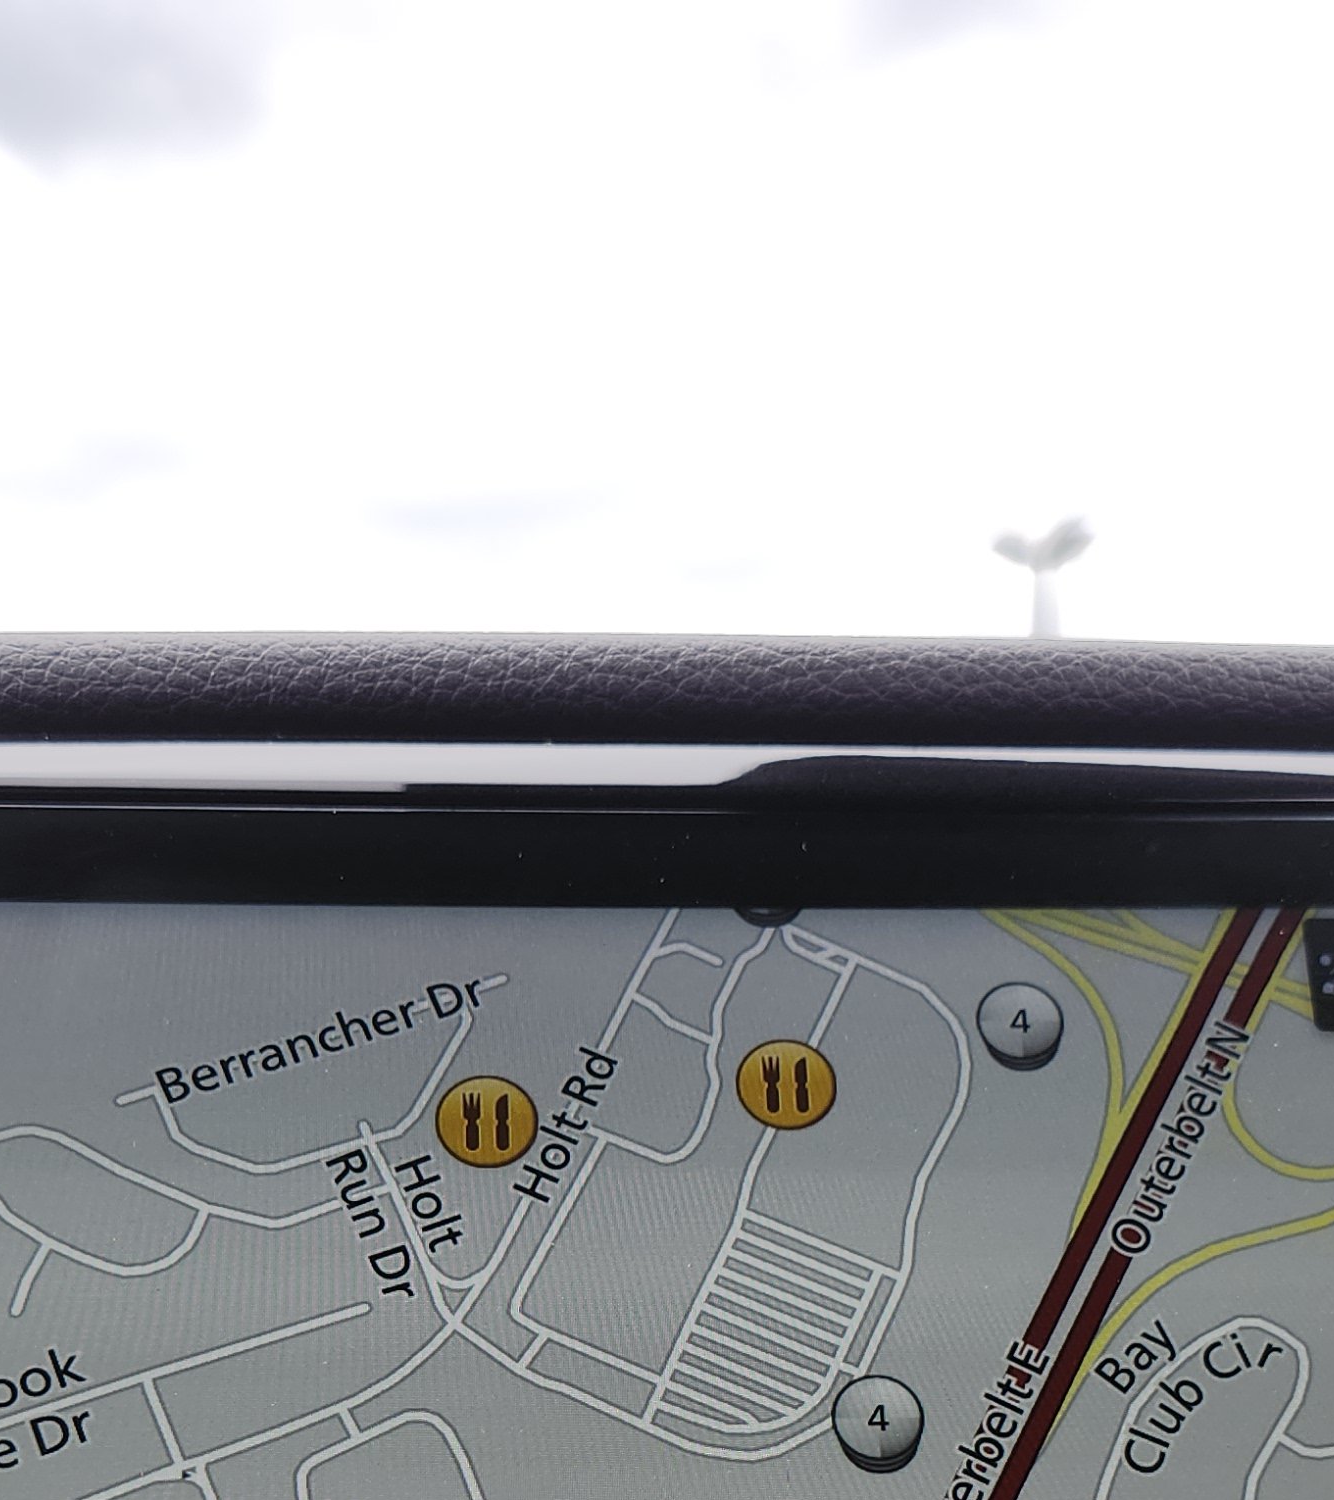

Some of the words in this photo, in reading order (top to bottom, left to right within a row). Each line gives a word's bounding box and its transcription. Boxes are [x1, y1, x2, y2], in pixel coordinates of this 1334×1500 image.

[155, 1000, 416, 1104] Berrancher
[427, 974, 484, 1018] Dr
[1010, 1008, 1030, 1035] 4
[514, 1112, 587, 1204] Holt
[578, 1047, 618, 1107] Rd
[1112, 1060, 1231, 1253] Outerbelt
[1205, 1021, 1251, 1058] N
[326, 1149, 387, 1240] Run
[368, 1245, 416, 1300] Dr
[395, 1155, 463, 1252] Holt
[1007, 1341, 1049, 1375] E
[1094, 1319, 1176, 1394] Bay
[1124, 1380, 1203, 1473] Club
[1203, 1333, 1283, 1379] Cir
[29, 1409, 91, 1457] Dr
[868, 1405, 889, 1432] 4
